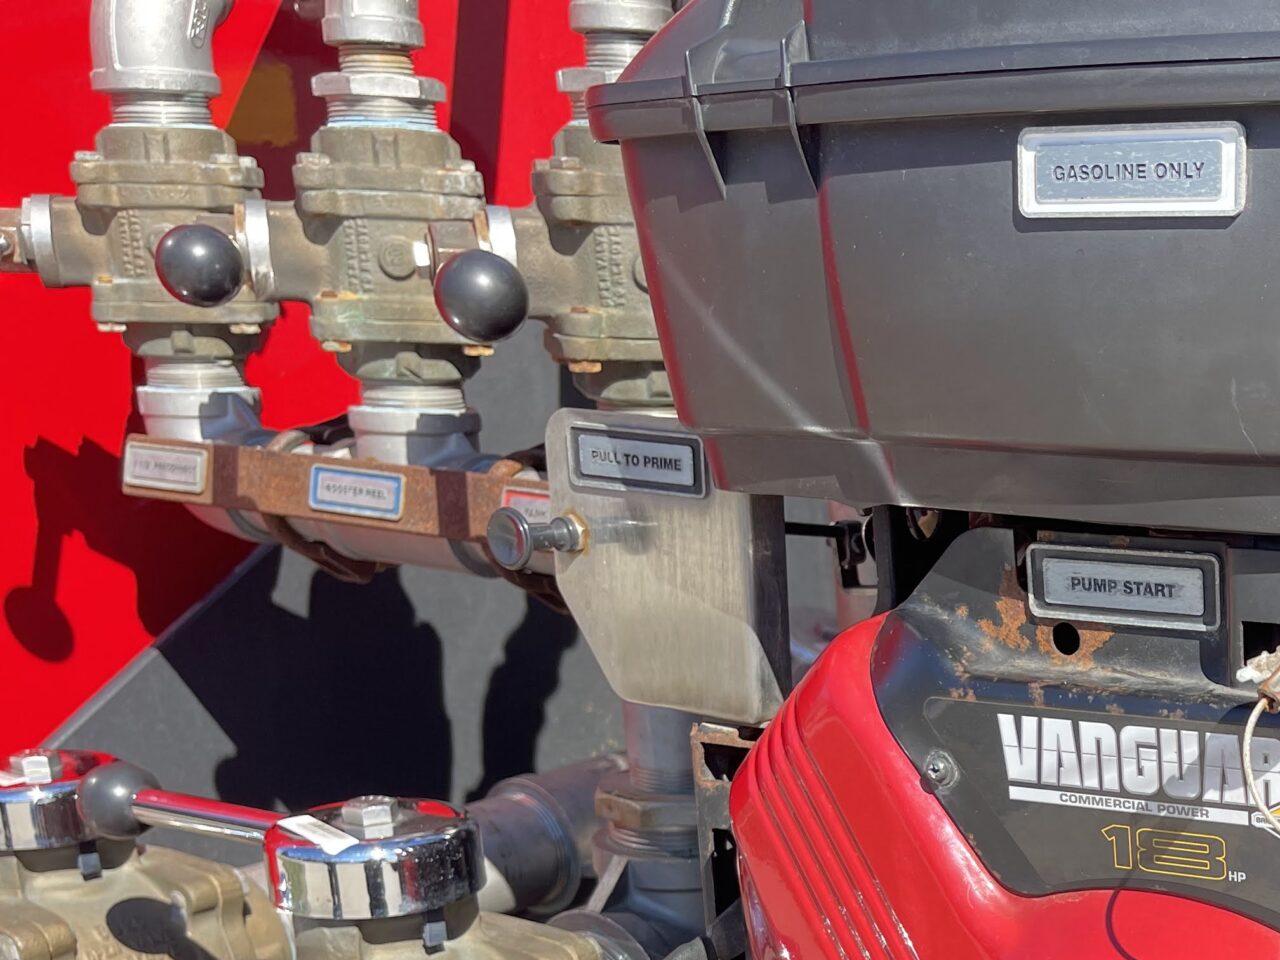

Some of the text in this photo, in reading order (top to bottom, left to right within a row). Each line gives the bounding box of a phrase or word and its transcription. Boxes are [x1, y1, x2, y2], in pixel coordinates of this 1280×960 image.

[1053, 161, 1205, 181] GASOLINE ONLY
[591, 450, 683, 472] PULL TO PRIME
[1071, 576, 1177, 598] PUMP START
[1059, 792, 1210, 820] COMMERCIAL POWER
[1101, 823, 1228, 881] 18
[1228, 869, 1247, 883] HP
